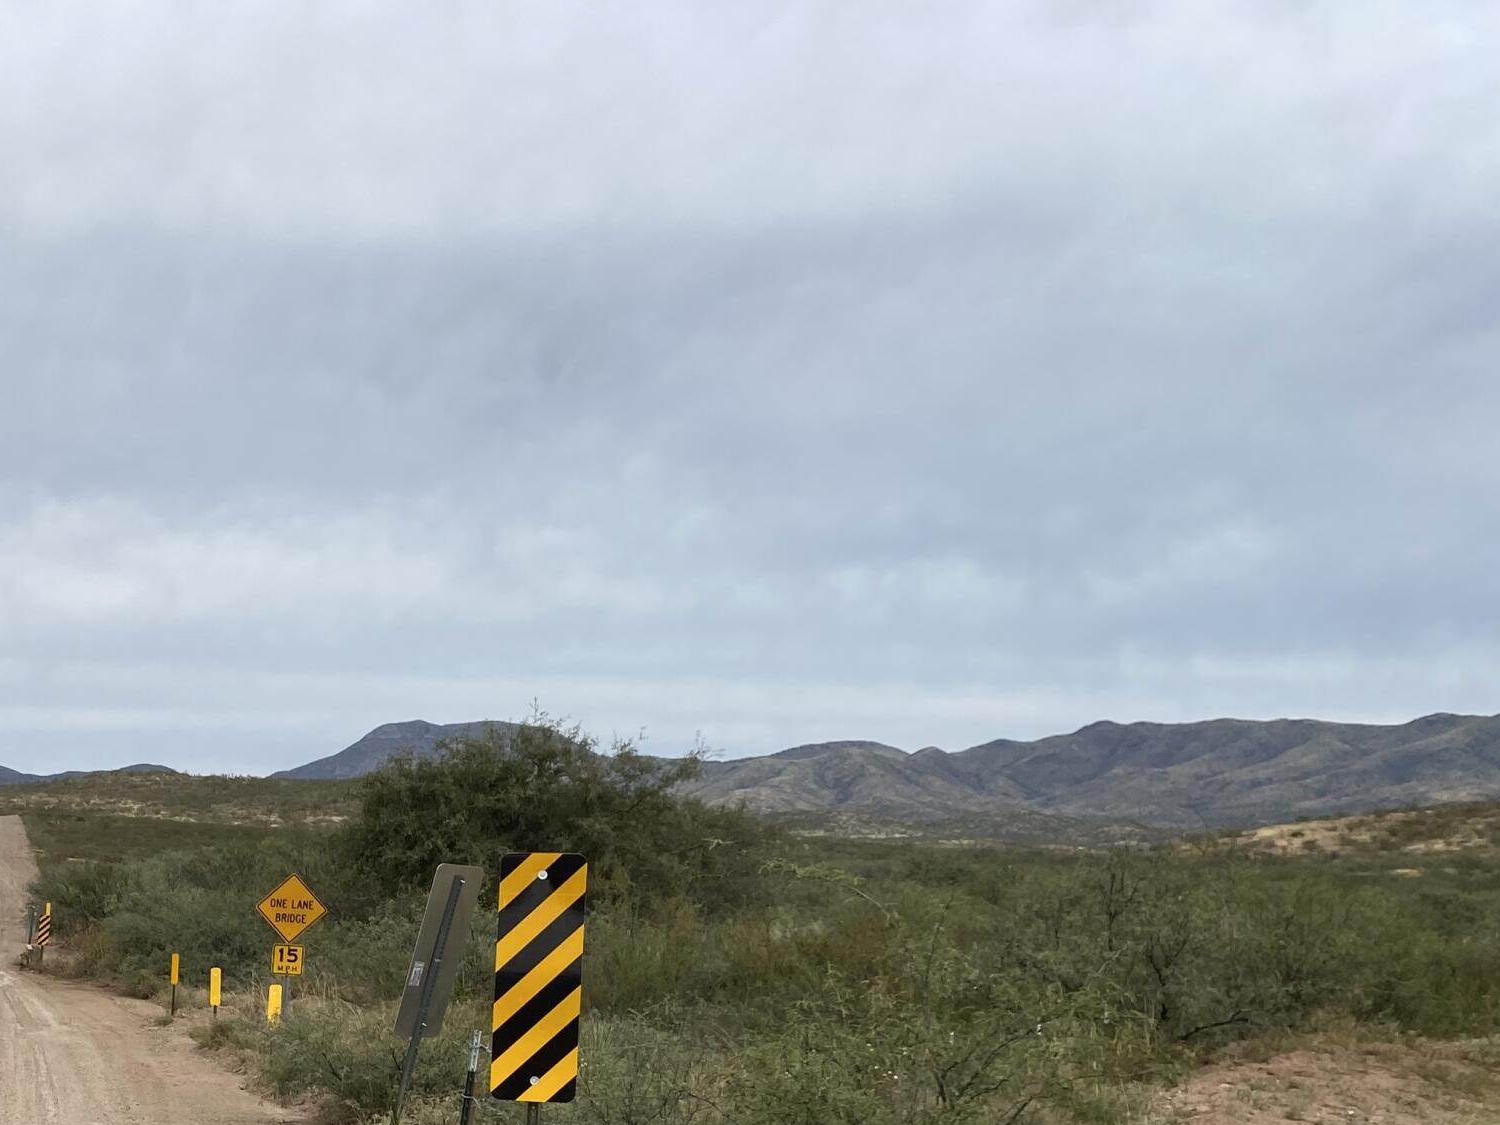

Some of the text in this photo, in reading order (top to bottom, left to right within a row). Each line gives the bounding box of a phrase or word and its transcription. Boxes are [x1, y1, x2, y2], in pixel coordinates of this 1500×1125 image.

[270, 898, 314, 910] ONE LANE
[275, 913, 307, 924] BRIDGE
[279, 947, 298, 963] 15
